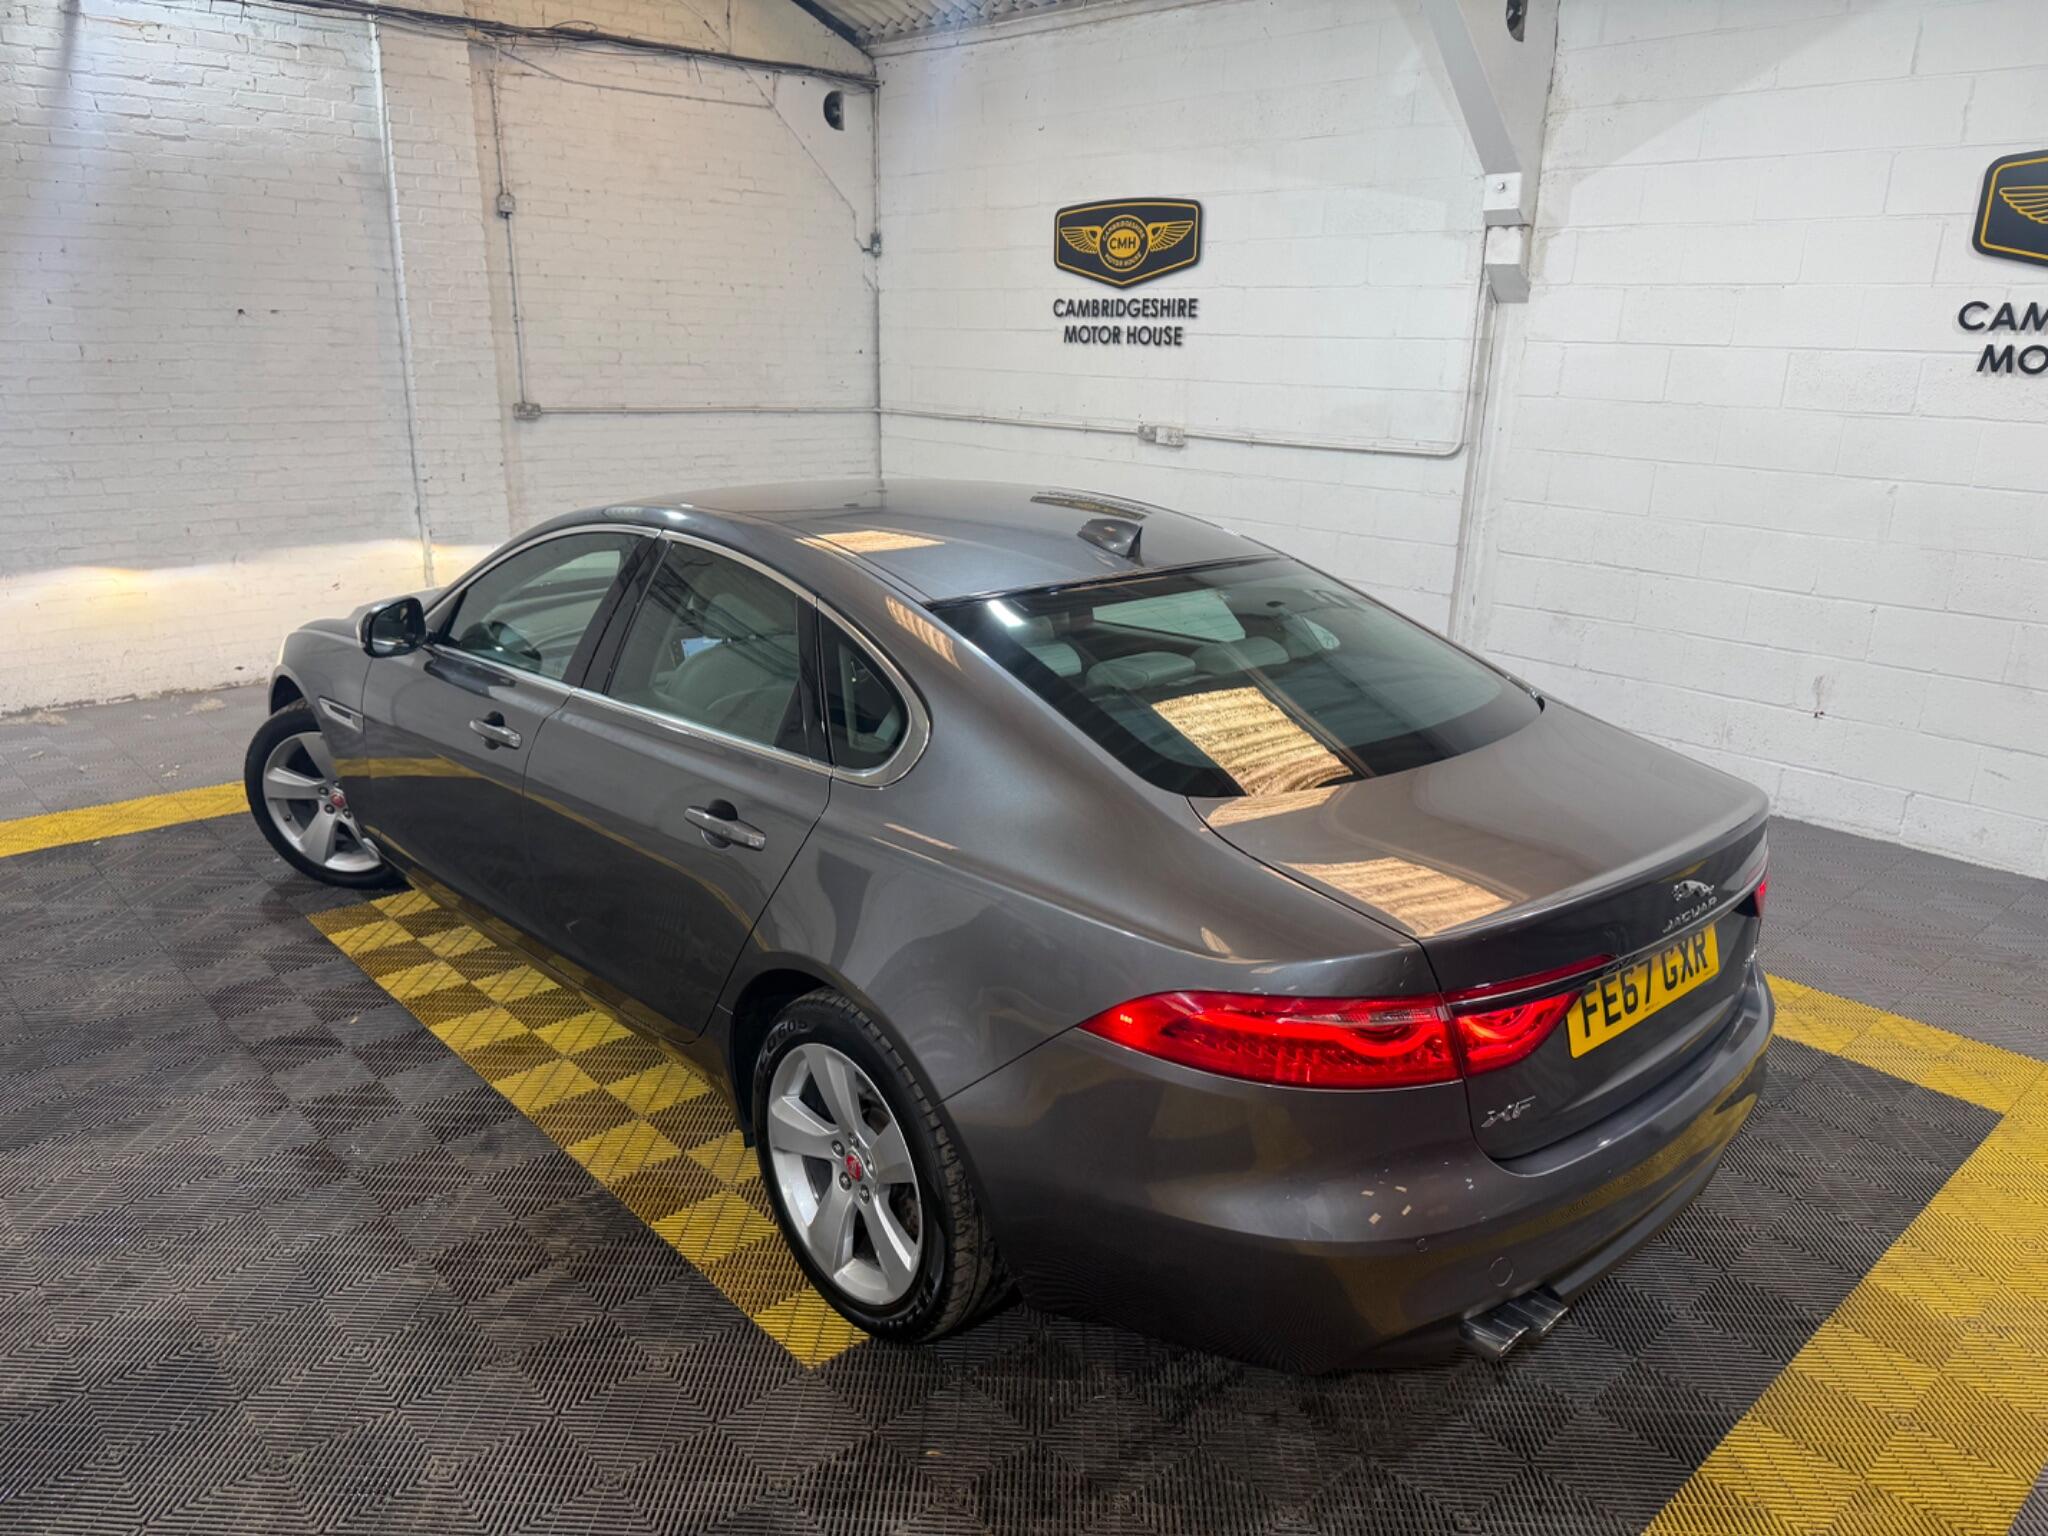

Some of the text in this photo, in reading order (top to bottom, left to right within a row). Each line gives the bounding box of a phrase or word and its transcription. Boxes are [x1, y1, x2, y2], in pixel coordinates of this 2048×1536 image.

[1109, 236, 1137, 250] CMH
[1053, 298, 1198, 318] CAMBRIDGESHIRE
[1063, 325, 1183, 346] MOTOR HOUSE
[1662, 896, 1717, 933] JAGUAR
[1580, 930, 1708, 1038] FE67 GXR
[1480, 1095, 1536, 1128] XF
